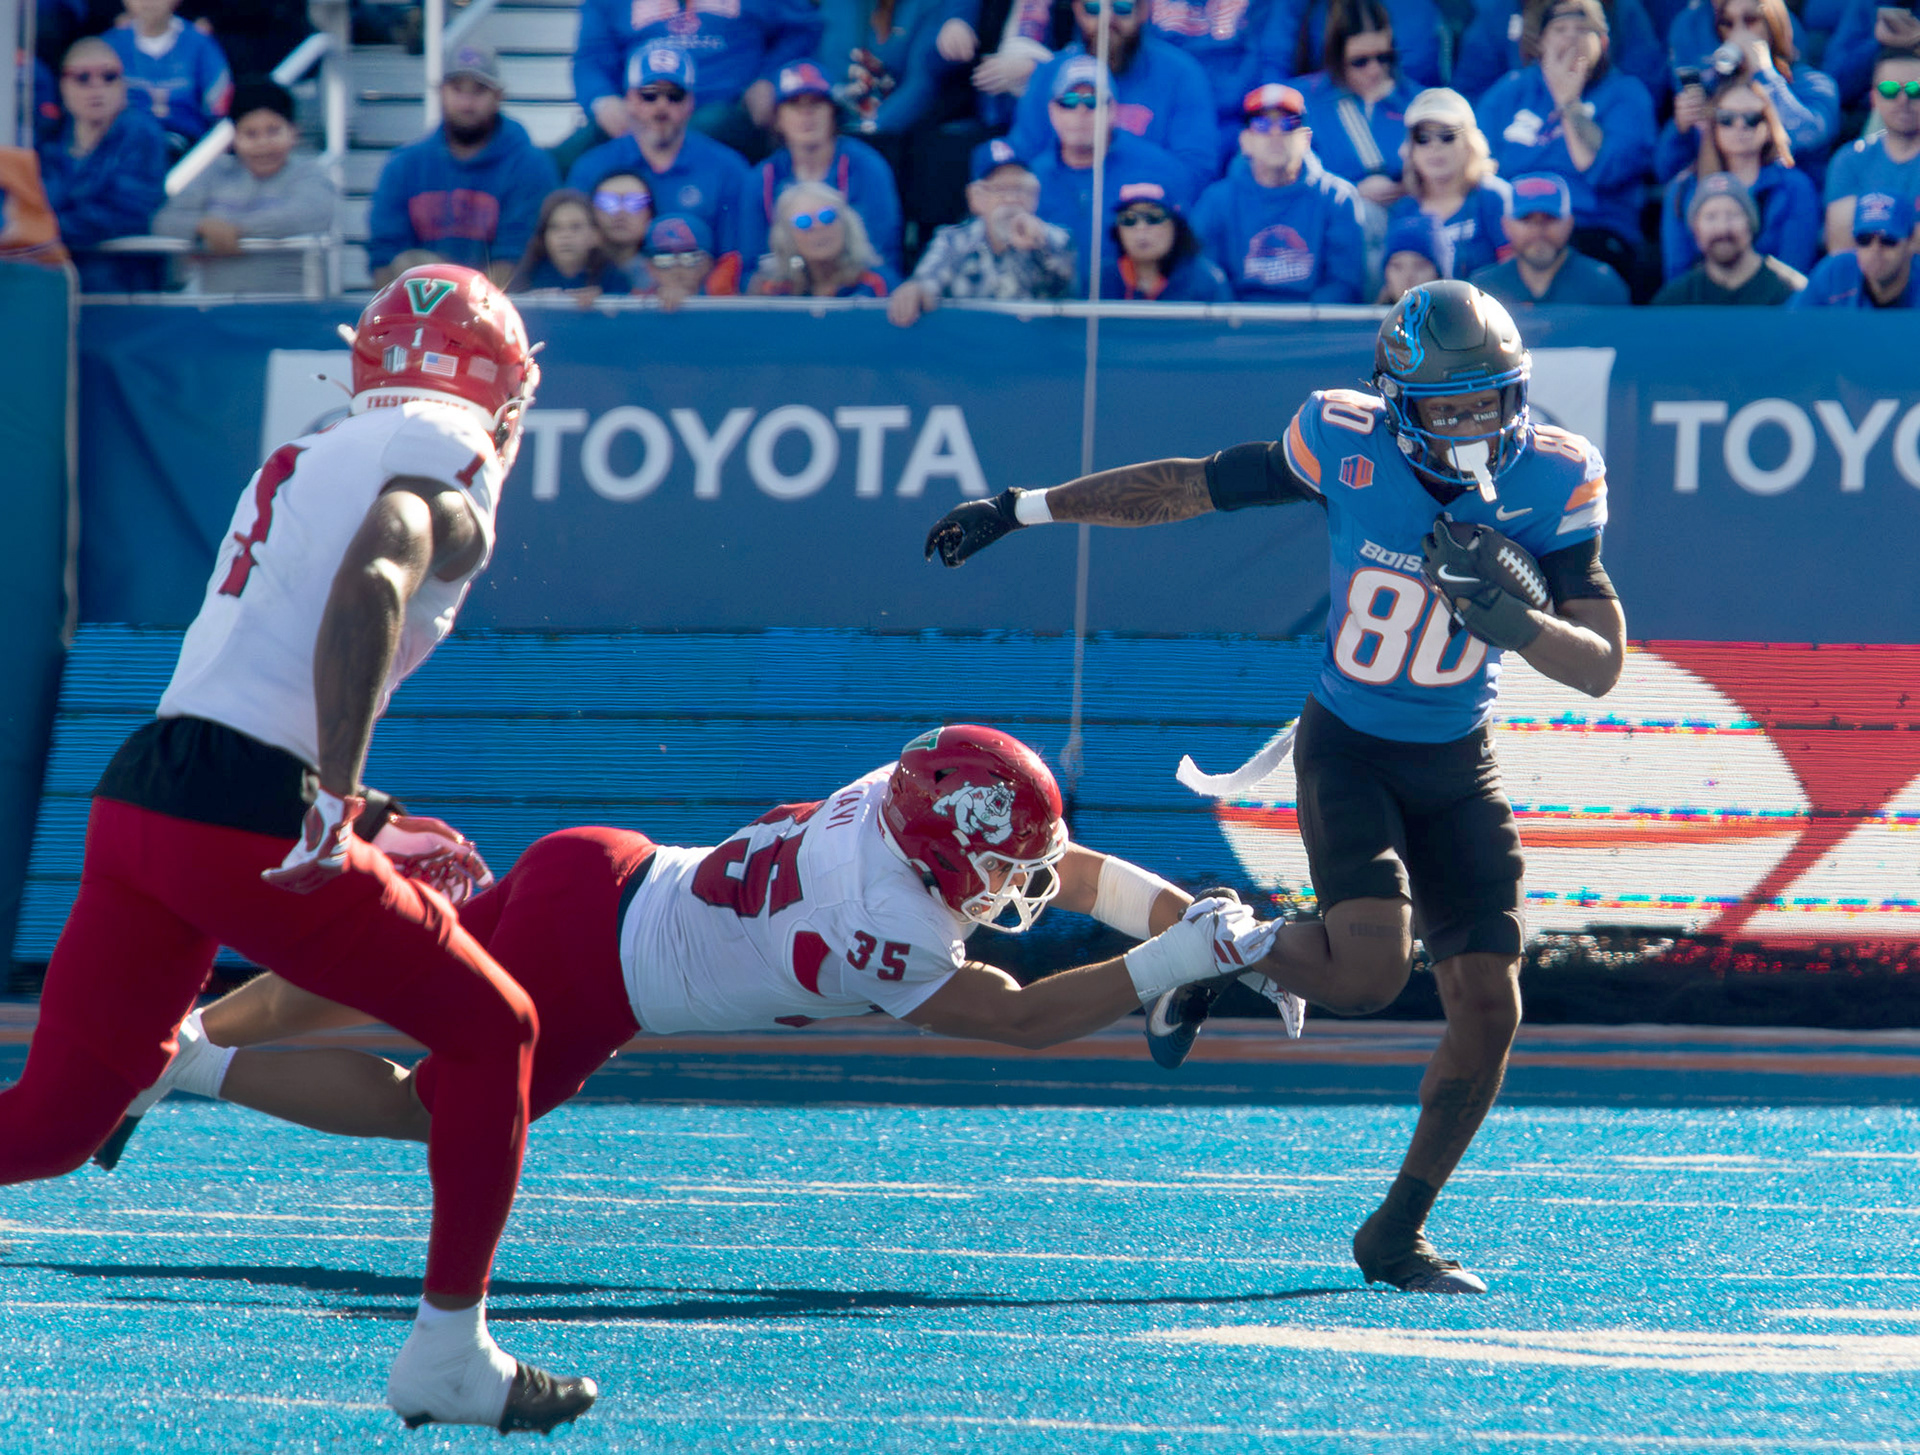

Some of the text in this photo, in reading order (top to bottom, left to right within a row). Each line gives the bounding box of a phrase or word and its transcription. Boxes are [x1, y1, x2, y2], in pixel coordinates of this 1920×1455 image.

[404, 278, 460, 317] V
[411, 328, 424, 349] 1
[522, 404, 991, 500] TOYOTA
[1359, 539, 1423, 573] BOIS
[1333, 566, 1489, 688] 80
[846, 929, 911, 981] 35
